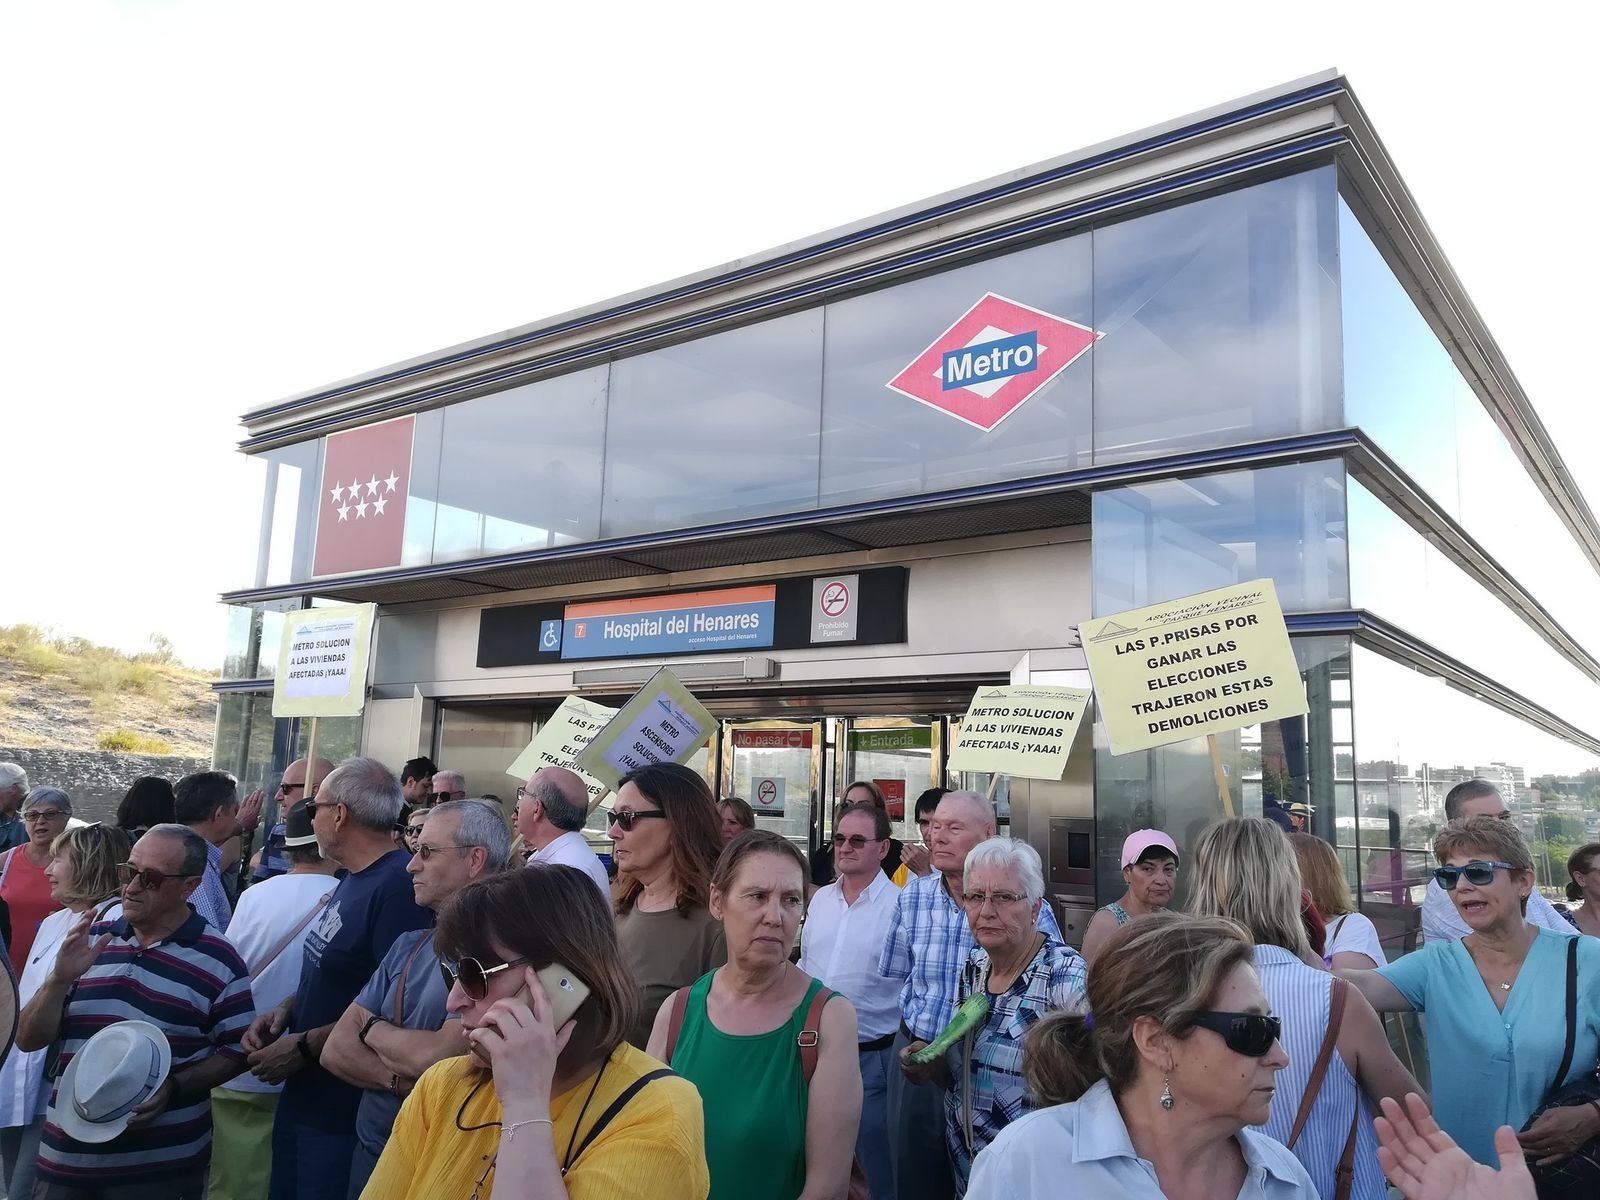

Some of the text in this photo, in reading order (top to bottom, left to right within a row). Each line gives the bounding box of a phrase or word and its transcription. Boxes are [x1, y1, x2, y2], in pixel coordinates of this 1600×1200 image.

[948, 344, 1034, 383] Metro
[578, 625, 584, 636] 7
[604, 612, 760, 640] Hospital del Henares
[818, 621, 848, 630] Prohibido
[706, 635, 727, 643] Hospital
[1115, 614, 1258, 655] LAS P.PRISAS POR
[292, 638, 350, 651] METRO SOLUCION
[290, 653, 346, 666] A LAS VIVIENDAS
[1147, 640, 1237, 669] GANAR LAS
[288, 668, 346, 679] AFECTADAS ¡YAAA!
[1147, 660, 1248, 691] ELECCIONES
[1132, 676, 1274, 716] TRAJERON ESTAS
[971, 707, 1075, 720] METRO SOLUCION
[1148, 699, 1269, 734] DEMOLICIONES
[568, 716, 587, 728] LAS
[660, 720, 680, 739] METRO
[965, 724, 1064, 737] A LAS VIVIENDAS
[640, 726, 675, 756] ASCENSORES
[738, 733, 785, 746] No pasar
[870, 734, 914, 747] Entrada
[959, 740, 1062, 754] AFECTADAS ¡YAAA!
